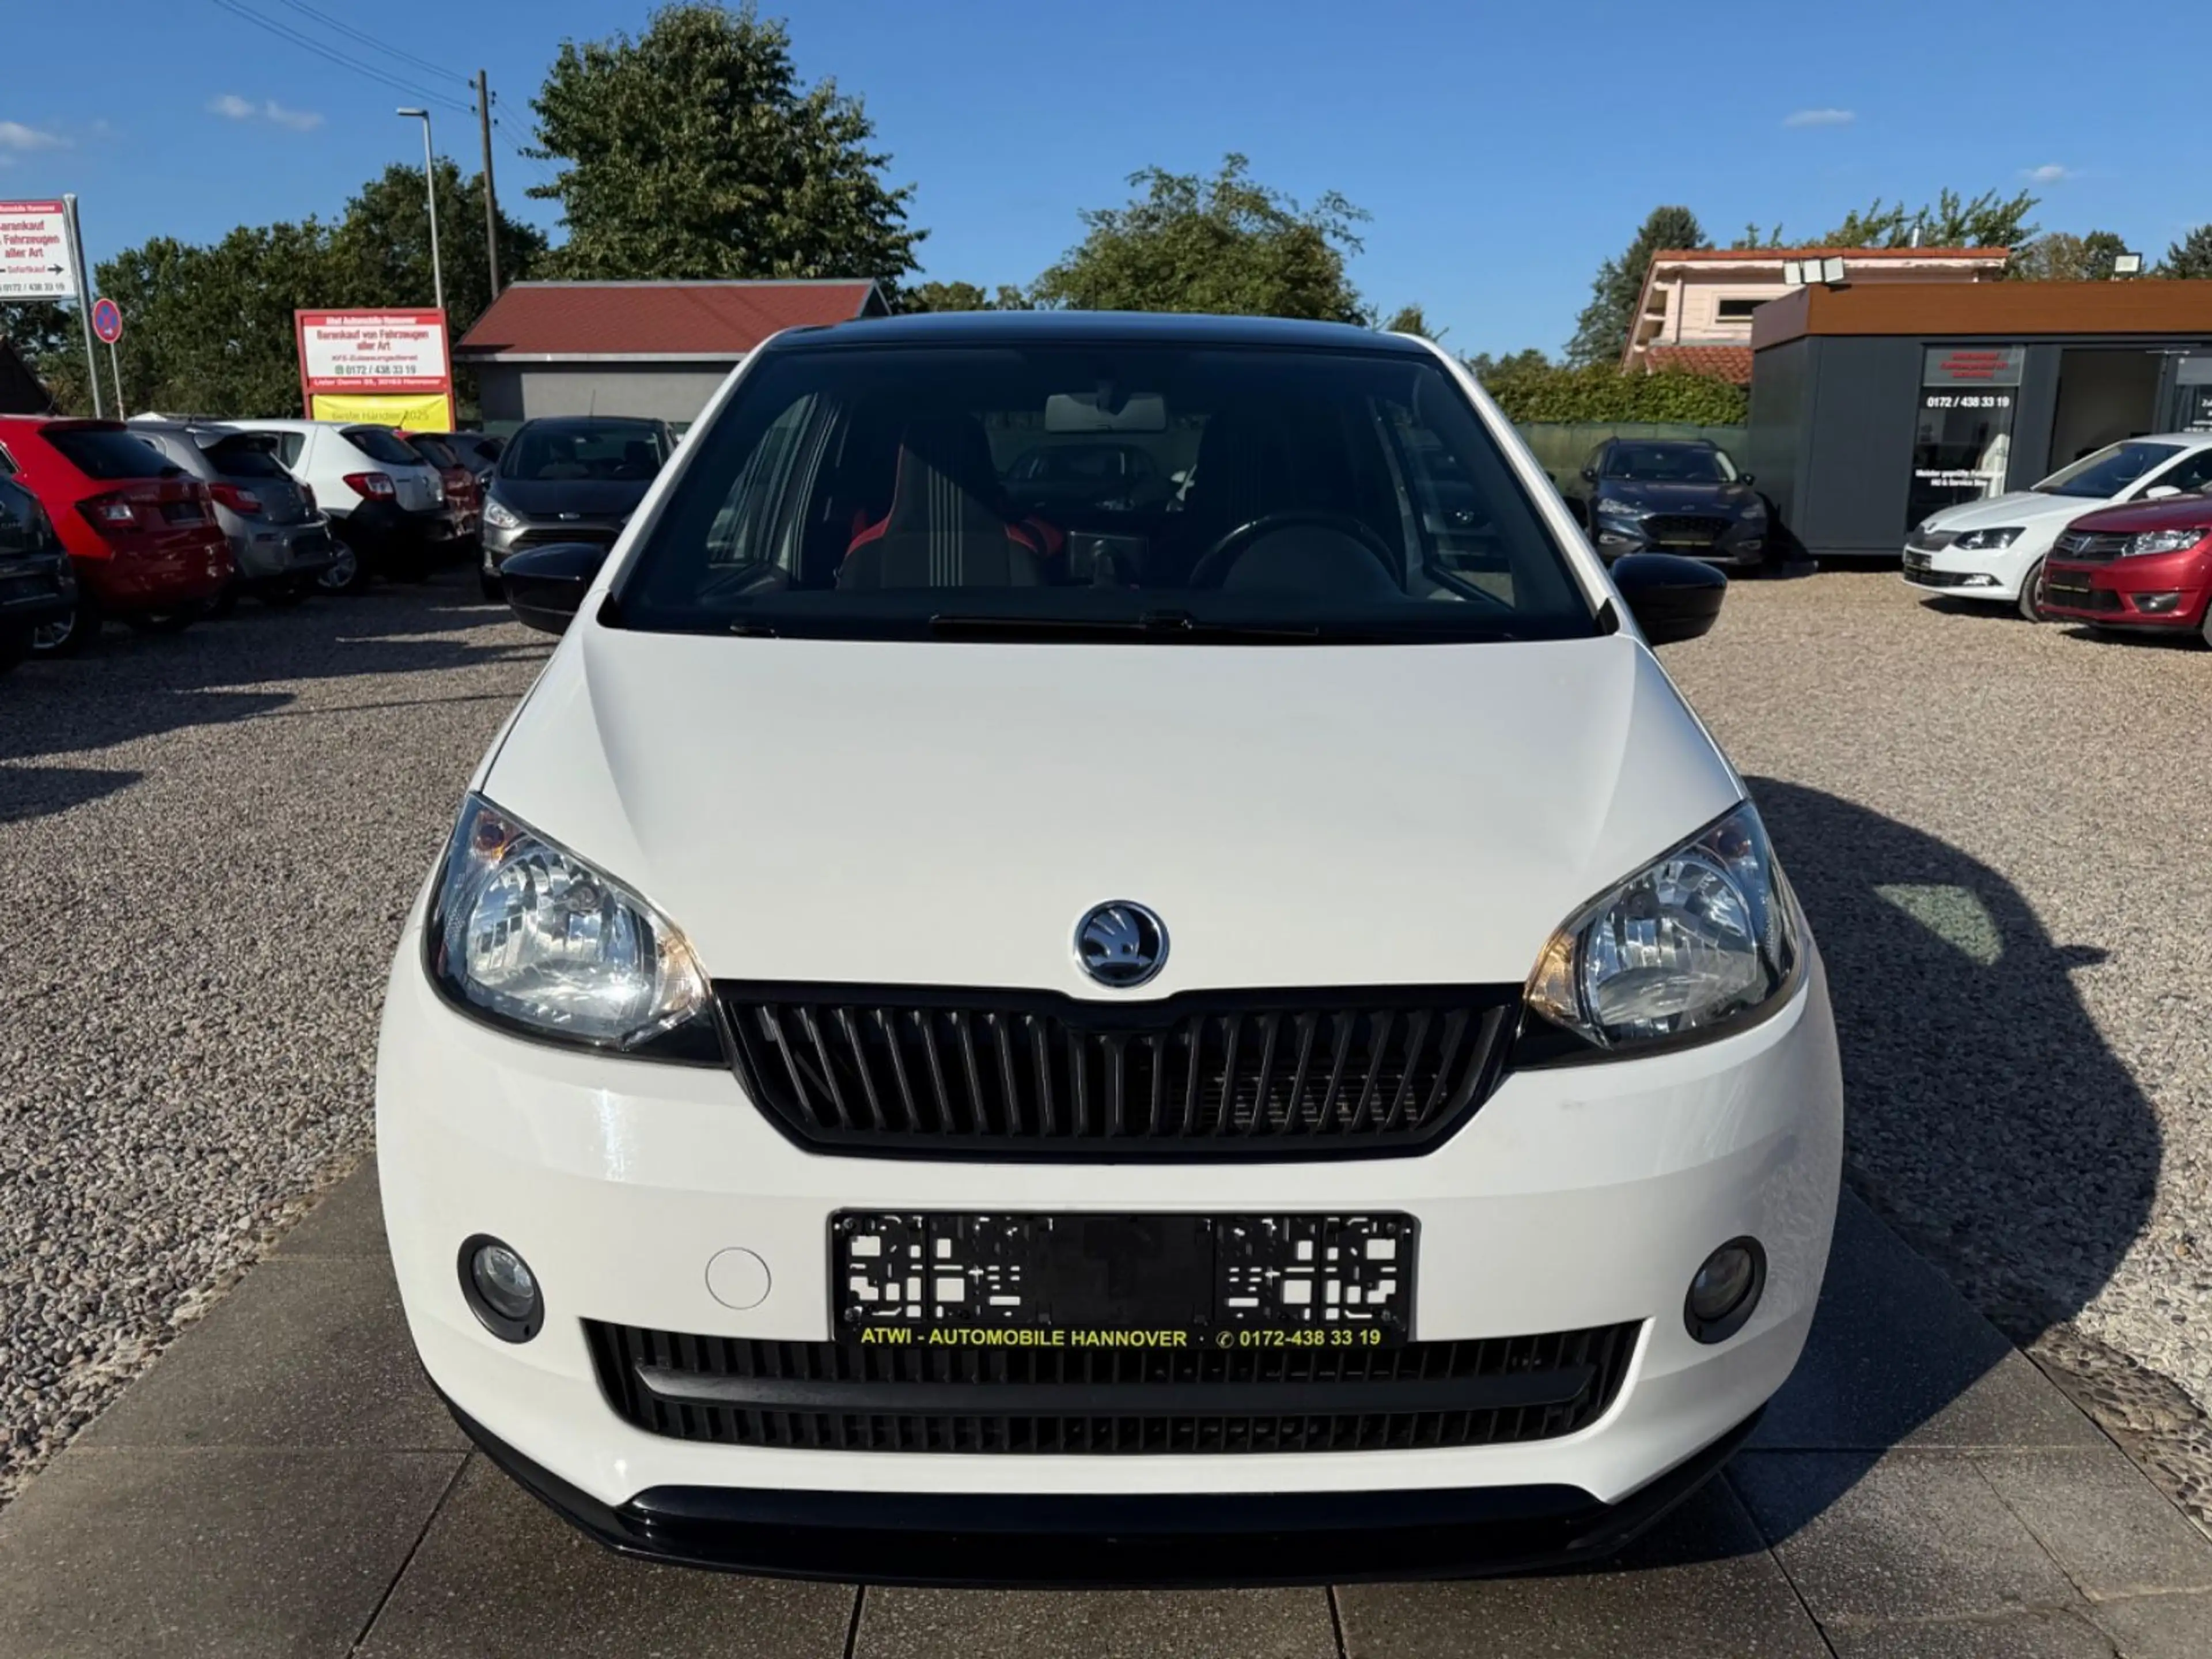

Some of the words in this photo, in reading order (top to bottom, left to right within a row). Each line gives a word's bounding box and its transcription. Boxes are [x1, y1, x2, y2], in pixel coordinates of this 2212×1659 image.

[29, 248, 44, 257] Art
[377, 342, 390, 351] Art
[346, 365, 367, 374] 0172
[375, 365, 391, 374] 438
[393, 365, 403, 374] 33
[406, 365, 416, 374] 19
[1927, 396, 1952, 407] 0172
[1960, 396, 1979, 407] 438
[1980, 396, 1994, 407] 33
[861, 1327, 912, 1344] ATWI
[929, 1328, 1065, 1346] AUTOMOBILE
[1071, 1330, 1187, 1347] HANNOVER
[1239, 1330, 1325, 1347] 0172-438
[1330, 1329, 1353, 1346] 33
[1359, 1328, 1381, 1345] 19
